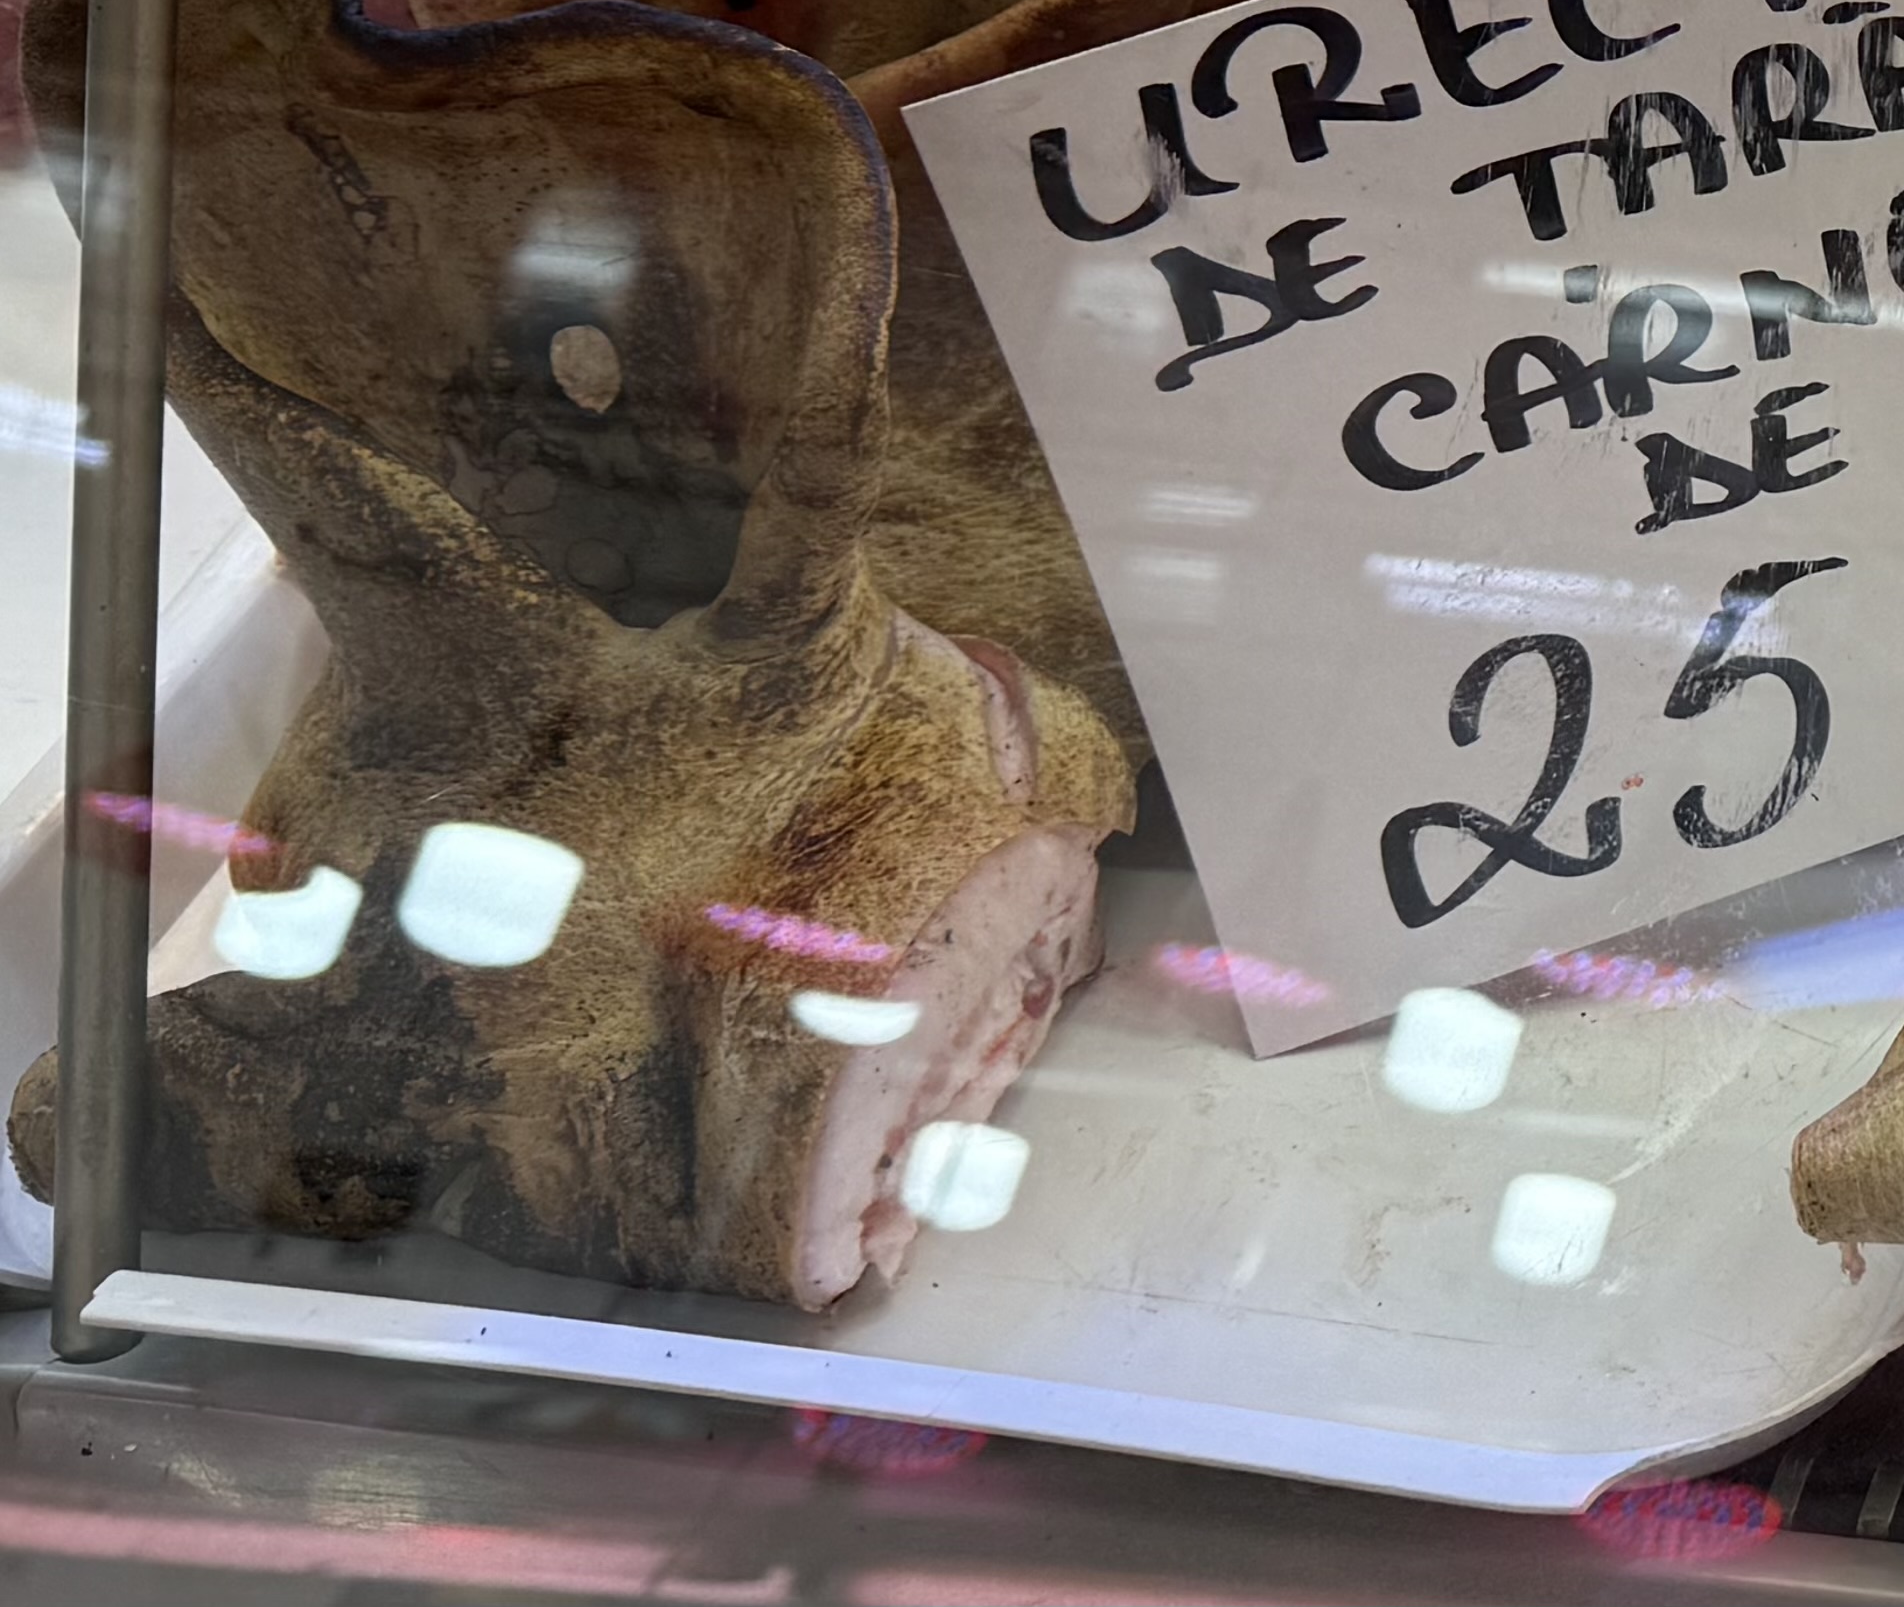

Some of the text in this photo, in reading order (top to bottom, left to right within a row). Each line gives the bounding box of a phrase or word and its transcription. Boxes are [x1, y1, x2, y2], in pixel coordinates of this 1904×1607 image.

[1152, 218, 1379, 392] DE
[1635, 383, 1850, 534] DE
[1381, 557, 1849, 928] 25
